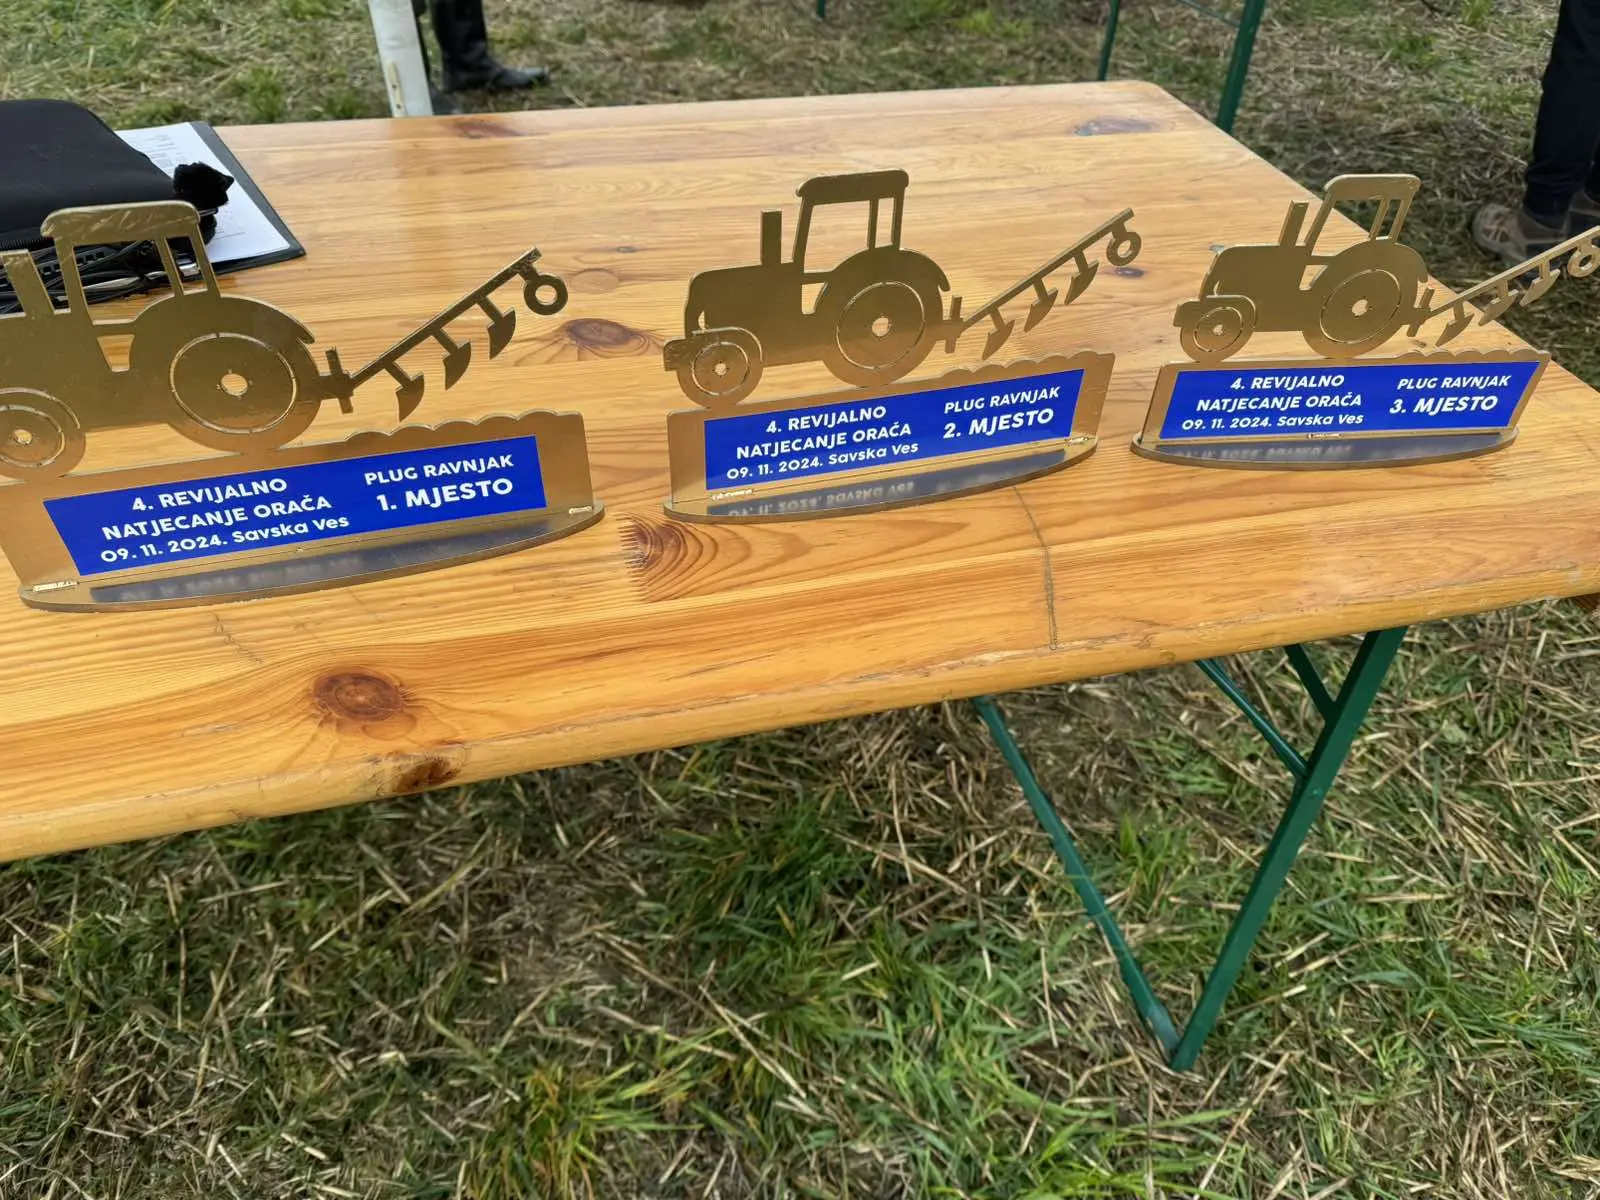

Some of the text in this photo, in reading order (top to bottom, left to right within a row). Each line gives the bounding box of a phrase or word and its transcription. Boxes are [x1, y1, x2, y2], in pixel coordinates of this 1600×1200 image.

[1230, 375, 1345, 391] 4. REVIJALNO
[1396, 375, 1512, 390] PLUG RAVNJAK
[944, 386, 1061, 414] PLUG RAVNJAK
[1196, 391, 1362, 412] NATJECANJE ORAČA
[1389, 395, 1499, 416] 3. MJESTO
[766, 406, 887, 434] 4. REVIJALNO
[943, 408, 1054, 439] 2. MJESTO
[1181, 414, 1364, 431] 09. 11. 2024. Savska Ves
[736, 432, 848, 460] NATJECANJE
[364, 454, 514, 486] PLUG RAVNJAK
[726, 443, 919, 480] 09. 11. 2024. Savska Ves
[132, 479, 288, 510] 4. REVIJALNO
[376, 477, 513, 511] 1. MJESTO
[101, 494, 332, 541] NATJECANJE ORAČA
[101, 516, 350, 563] 09. 11. 2024. Savska Ves
